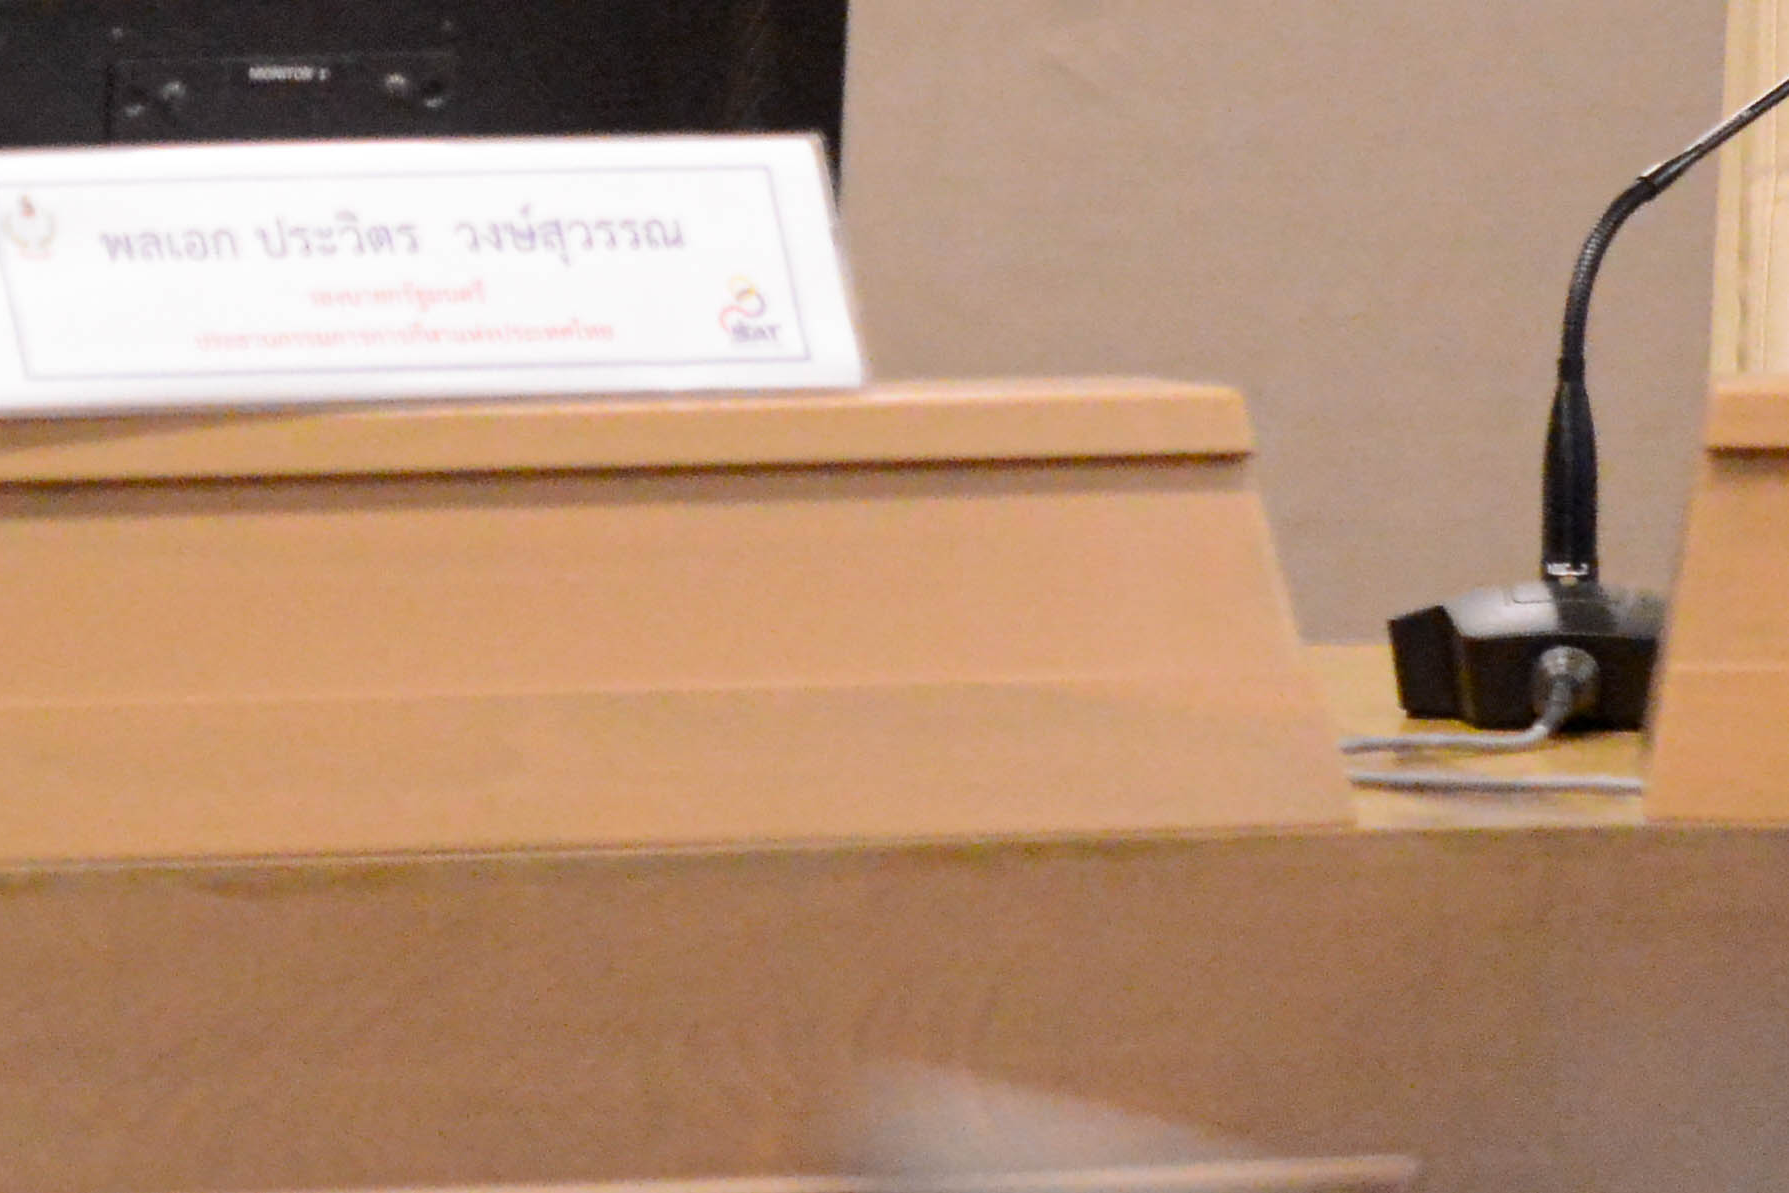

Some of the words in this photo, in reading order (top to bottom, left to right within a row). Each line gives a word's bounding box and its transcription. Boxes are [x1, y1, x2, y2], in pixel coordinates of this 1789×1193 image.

[99, 224, 240, 263] พลเอก
[256, 207, 420, 259] ประวิตร
[456, 202, 687, 267] วงษ์สุวรรณ
